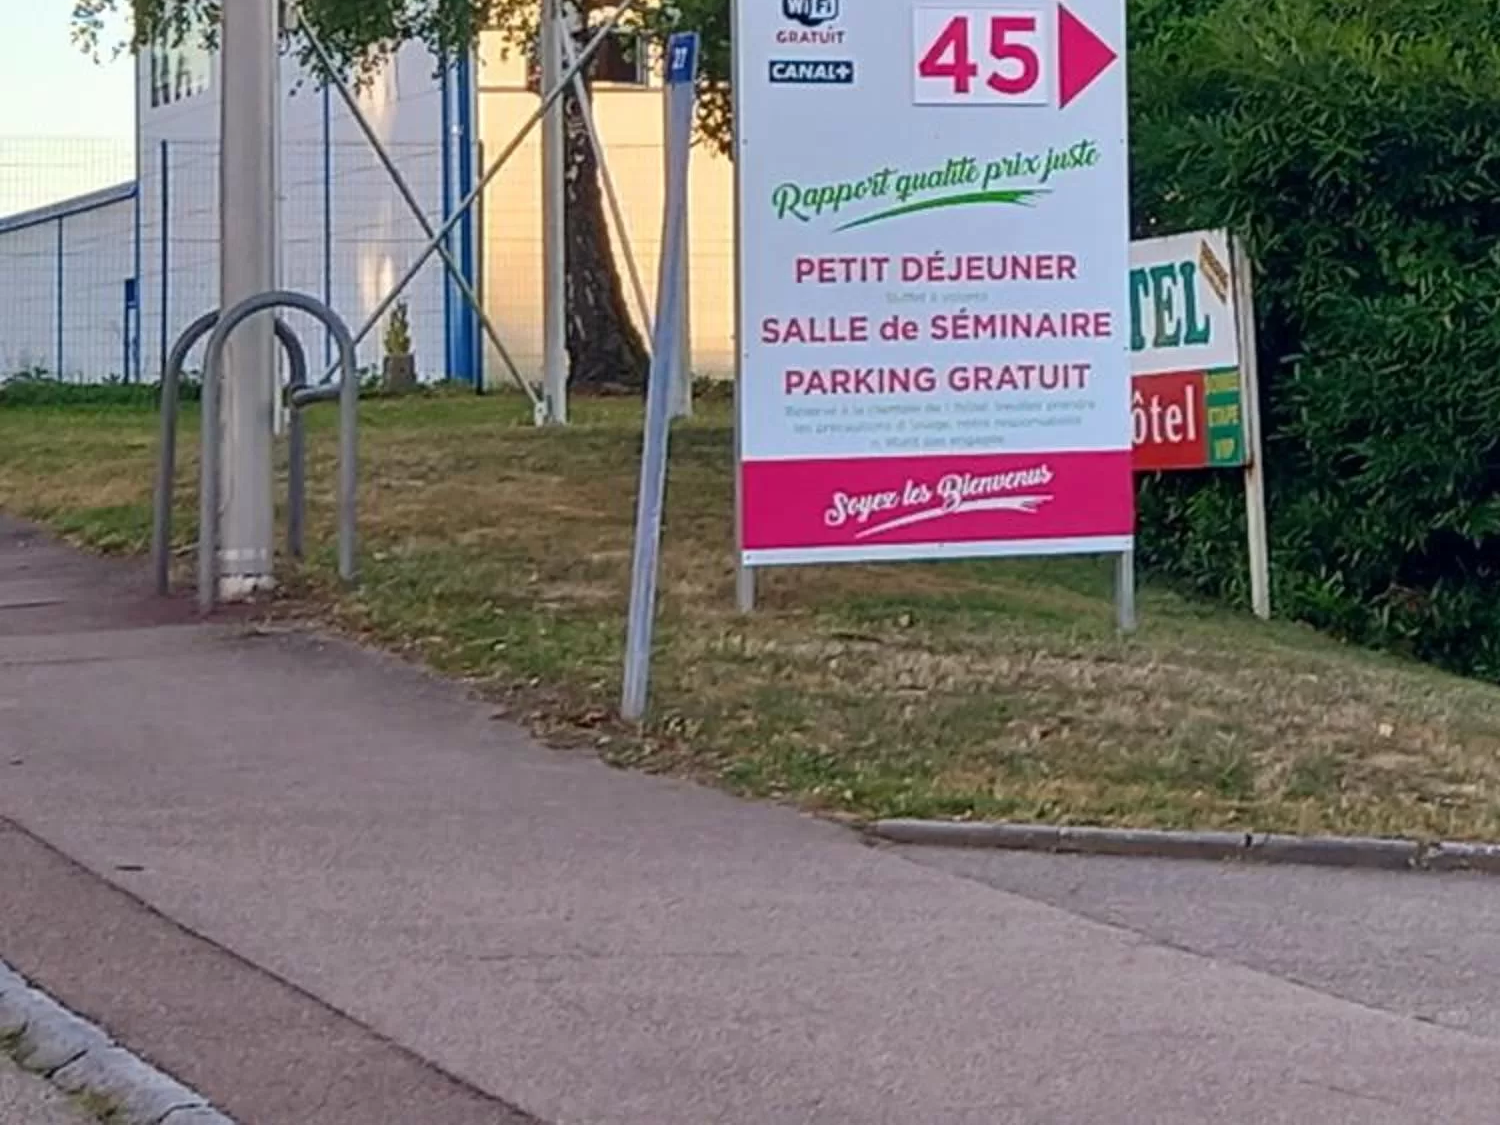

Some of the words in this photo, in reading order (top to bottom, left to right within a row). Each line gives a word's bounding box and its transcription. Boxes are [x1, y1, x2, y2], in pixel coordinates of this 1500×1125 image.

[776, 29, 845, 44] GRATUIT
[772, 63, 851, 80] CANAL+
[919, 16, 1040, 95] 45
[772, 165, 898, 223] Rapport
[895, 156, 981, 201] qualité
[980, 150, 1042, 191] prix
[1041, 138, 1102, 183] juste
[795, 256, 889, 283] PETIT
[902, 251, 1076, 281] DÉJEUNER
[762, 316, 868, 344] SALLE
[880, 314, 919, 341] de
[931, 308, 1112, 340] SÉMINAIRE
[785, 366, 936, 395] PARKING
[948, 363, 1091, 392] GRATUIT
[824, 486, 899, 526] Soyez
[903, 479, 932, 506] les
[937, 463, 1054, 511] Bienvenus
